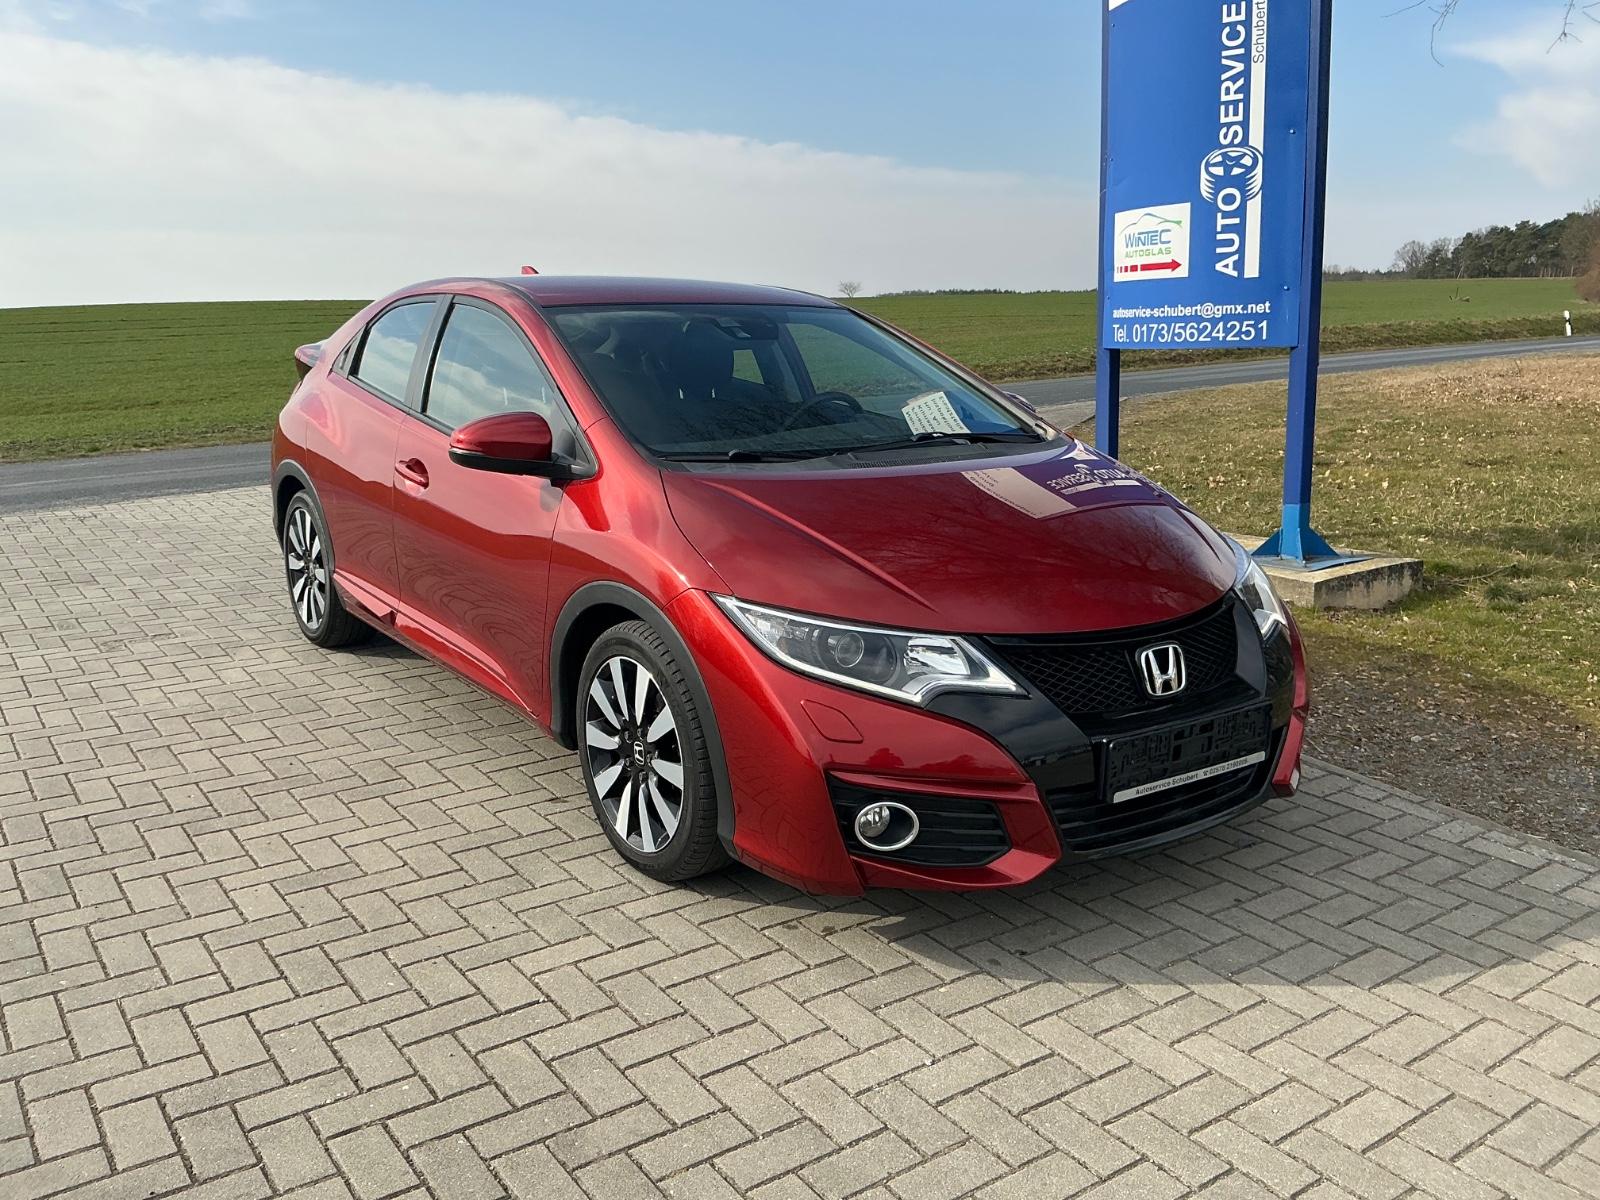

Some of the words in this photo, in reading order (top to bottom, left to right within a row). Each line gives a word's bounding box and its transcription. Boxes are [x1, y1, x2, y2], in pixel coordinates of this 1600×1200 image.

[1252, 0, 1266, 64] Schubert
[1219, 0, 1246, 146] SERVICE
[1215, 187, 1241, 278] AUTO
[1125, 247, 1172, 258] AUTOGLAS
[1112, 301, 1271, 318] autoservice-schubert@gmx.net
[1113, 324, 1129, 343] Tel.
[1132, 320, 1268, 342] 0173/5624251
[1135, 782, 1171, 795] Autoservice
[1171, 773, 1199, 786] Schubert
